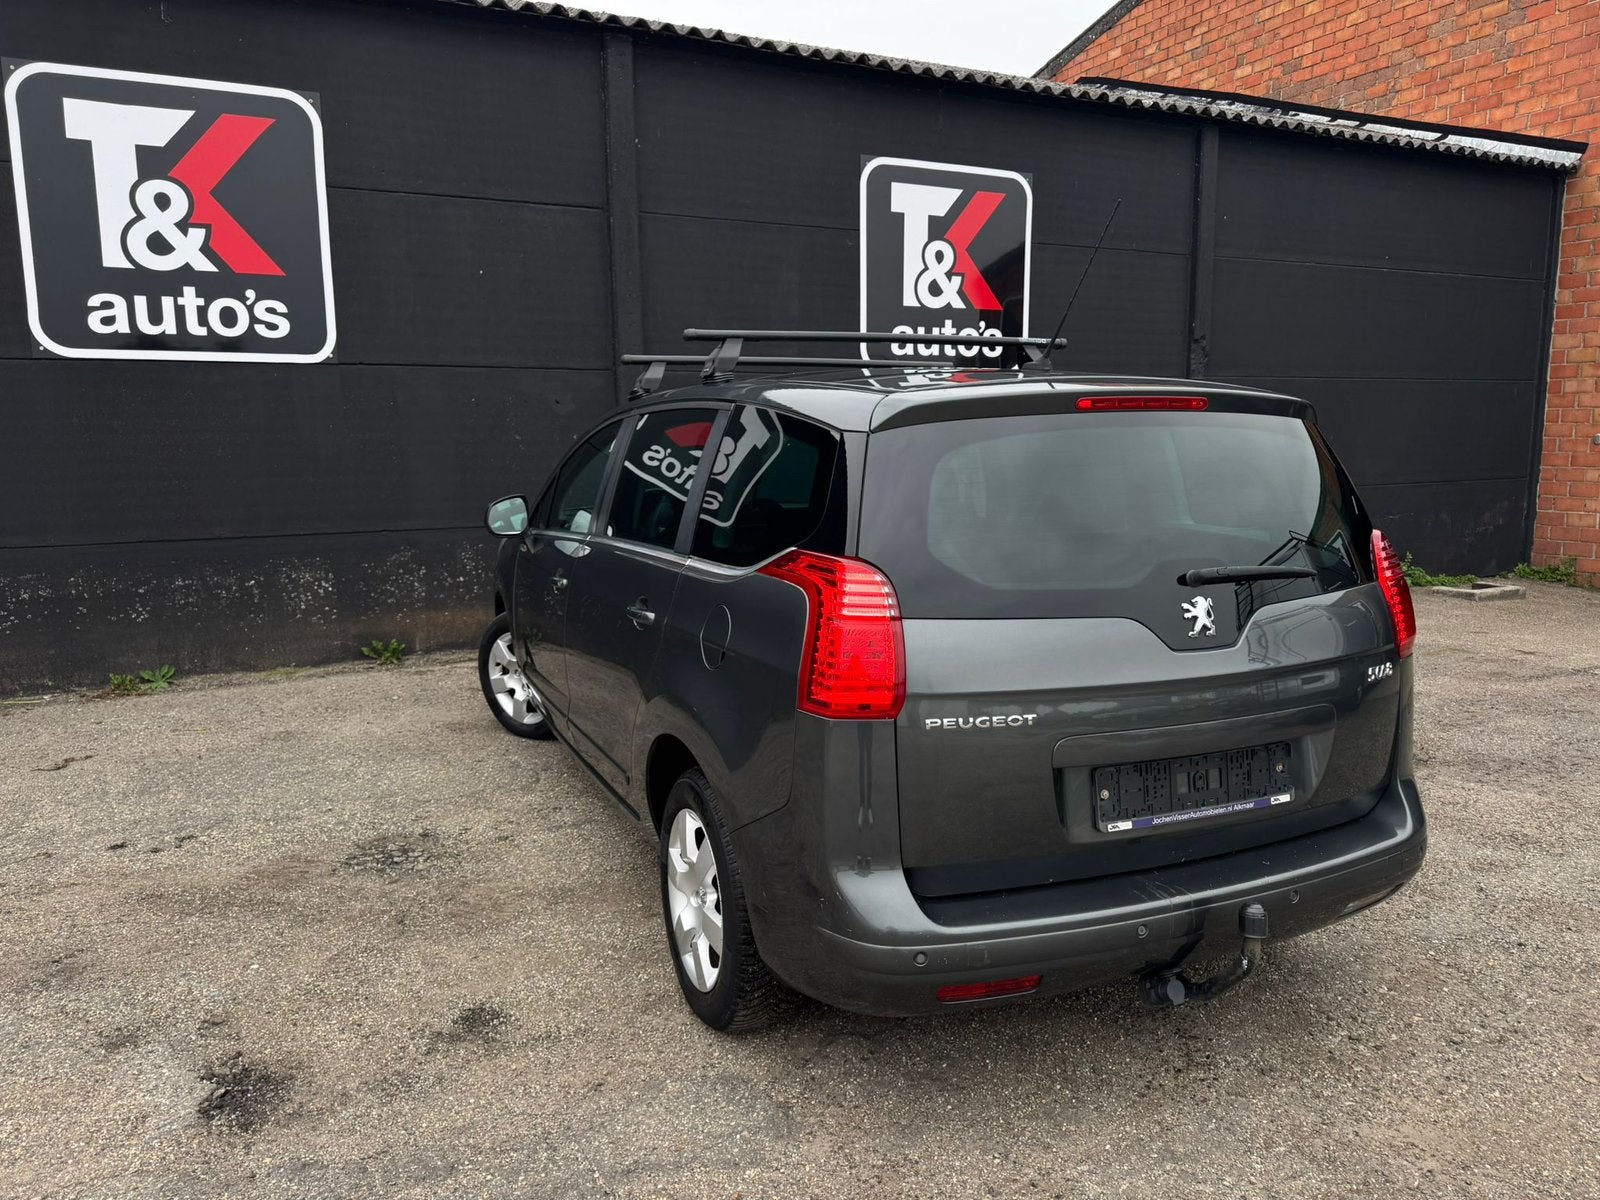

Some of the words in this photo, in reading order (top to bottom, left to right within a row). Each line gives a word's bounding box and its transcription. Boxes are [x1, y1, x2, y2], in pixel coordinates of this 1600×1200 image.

[62, 97, 287, 277] T&K
[890, 181, 1007, 311] T&K
[86, 286, 291, 339] auto's
[890, 319, 1004, 358] auto's
[925, 713, 1037, 730] PEUGEOT
